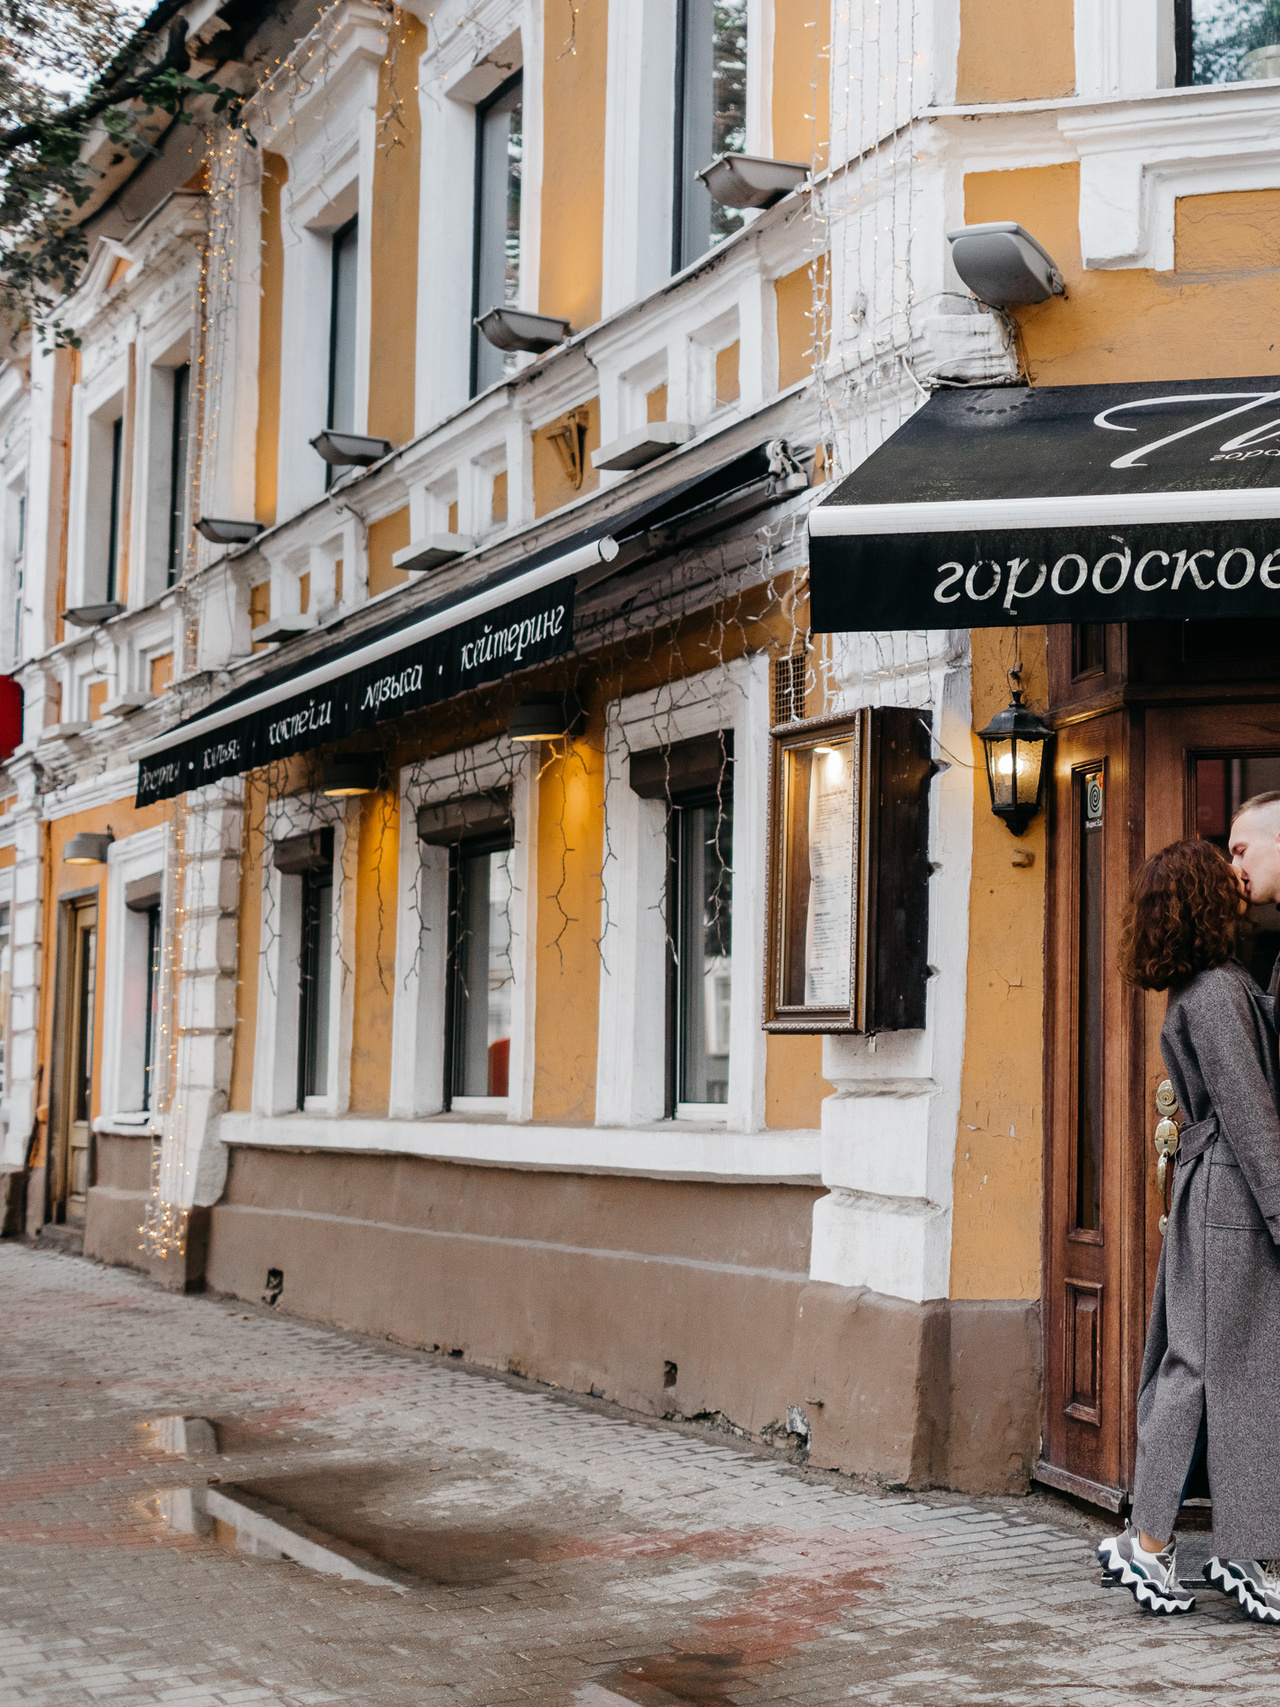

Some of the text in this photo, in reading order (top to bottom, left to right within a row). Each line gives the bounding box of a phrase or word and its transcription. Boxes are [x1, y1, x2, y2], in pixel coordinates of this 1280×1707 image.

[139, 760, 182, 794] десрт
[202, 738, 241, 771] клья
[361, 664, 423, 714] музыка
[461, 605, 565, 671] кейтеринг
